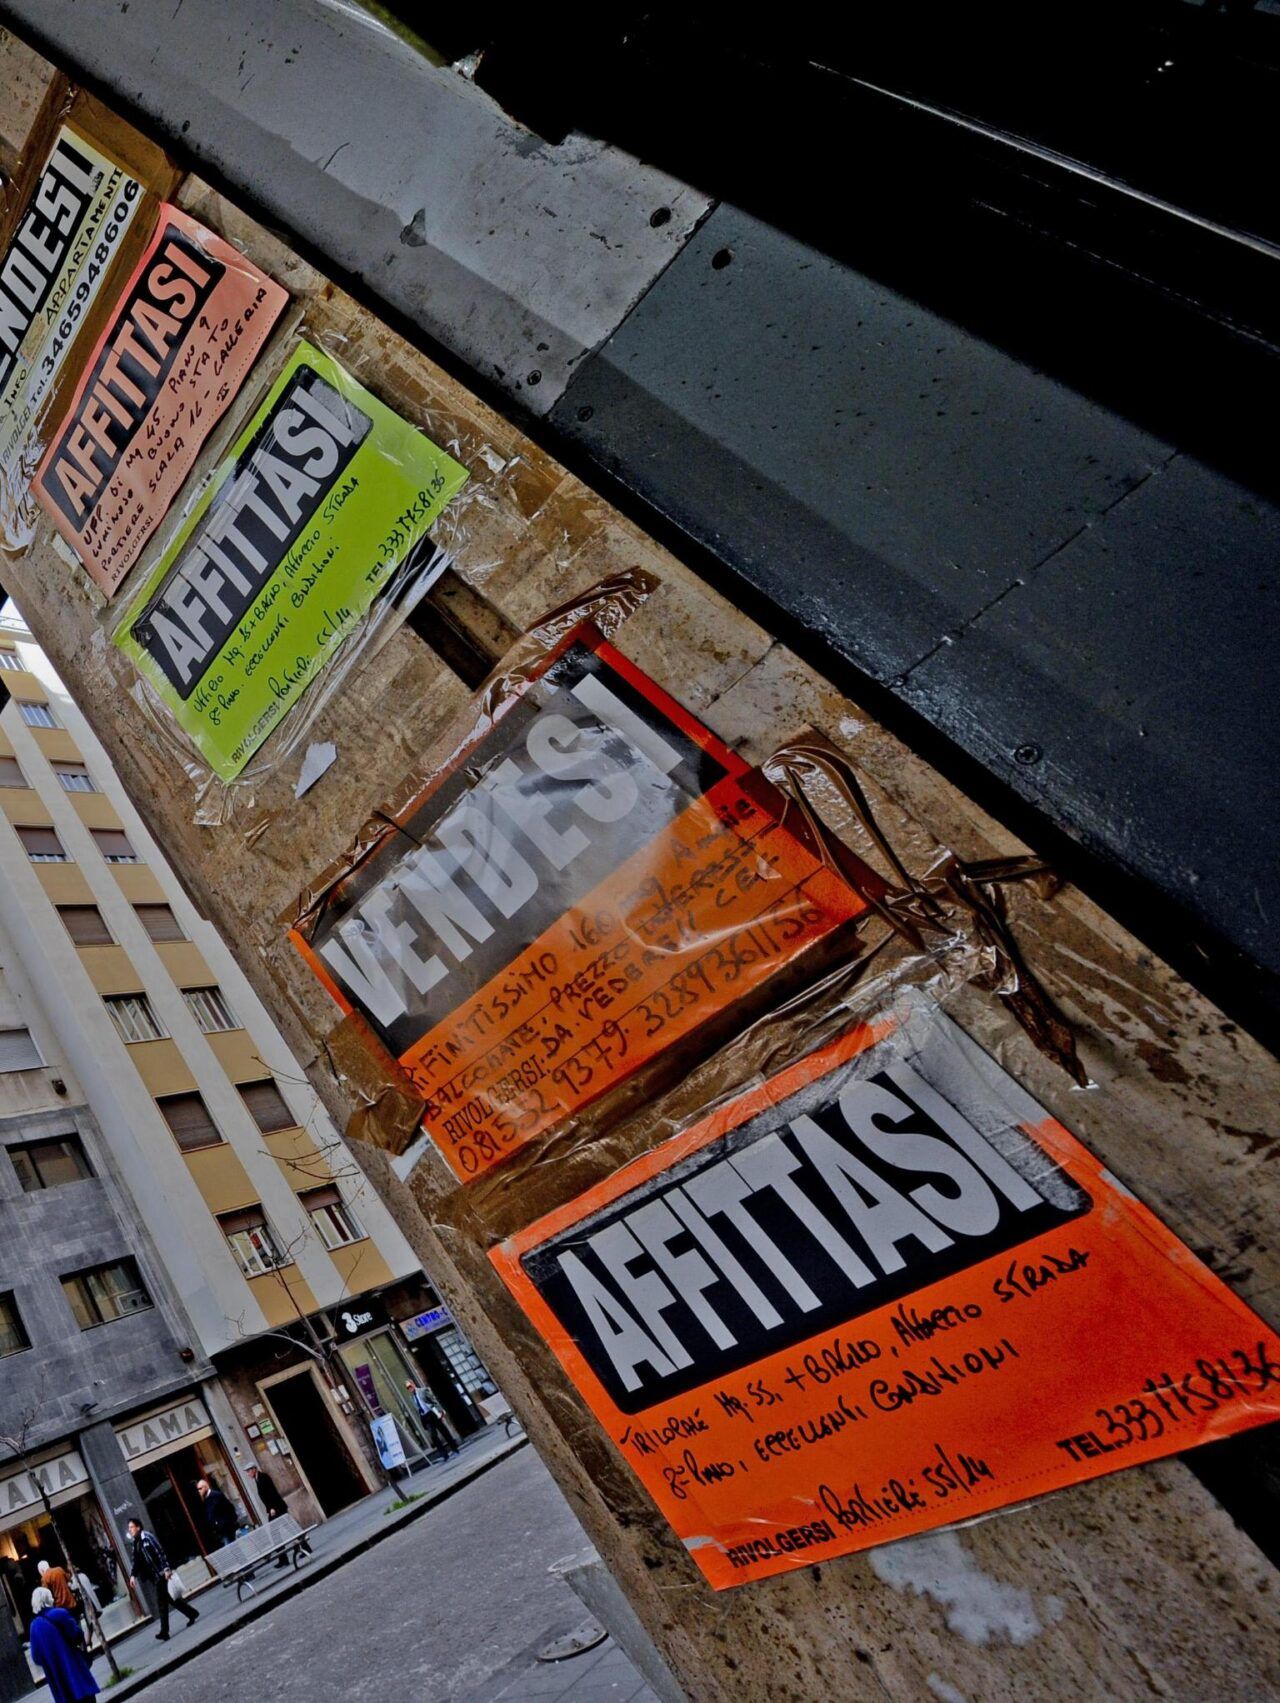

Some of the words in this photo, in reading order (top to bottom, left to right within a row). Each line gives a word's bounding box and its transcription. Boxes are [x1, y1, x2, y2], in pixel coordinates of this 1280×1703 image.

[55, 242, 209, 516] AFFITTASI
[111, 515, 153, 581] RIVOLGERSI
[149, 437, 184, 492] SCALA
[149, 386, 354, 684] AFFITTASI
[320, 673, 683, 1027] VENDESI
[556, 1060, 1043, 1391] AFFITTASI
[121, 1405, 203, 1456] LAMA
[725, 1519, 835, 1567] RIVOLGERSI
